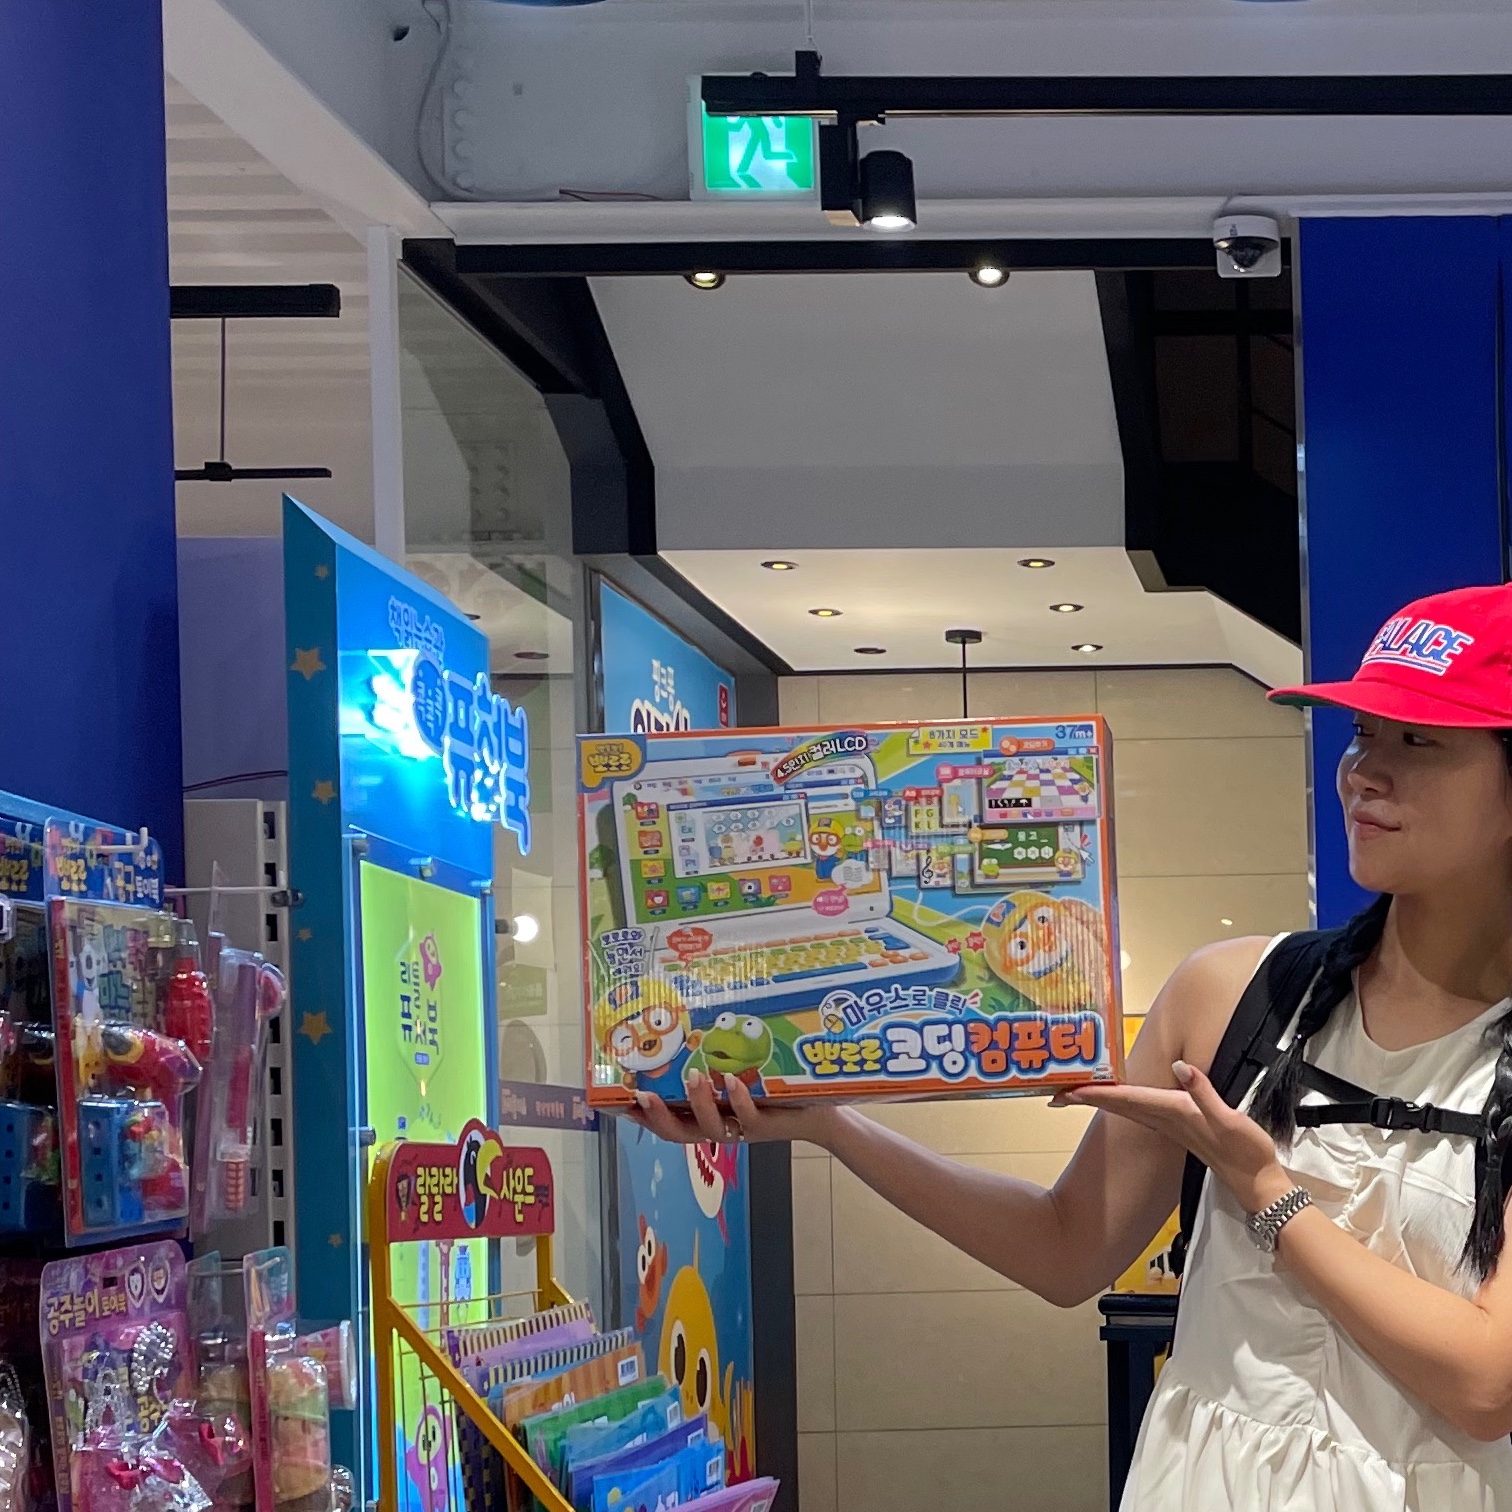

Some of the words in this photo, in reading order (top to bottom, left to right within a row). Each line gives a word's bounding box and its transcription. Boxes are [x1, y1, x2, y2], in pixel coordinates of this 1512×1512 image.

[843, 986, 928, 1027] 마우스로
[932, 990, 968, 1015] 클릭
[802, 1038, 884, 1075] 뽀로로
[417, 1167, 458, 1222] 랄랄라
[501, 1167, 535, 1223] 사운드
[47, 1287, 99, 1335] 공주놀이
